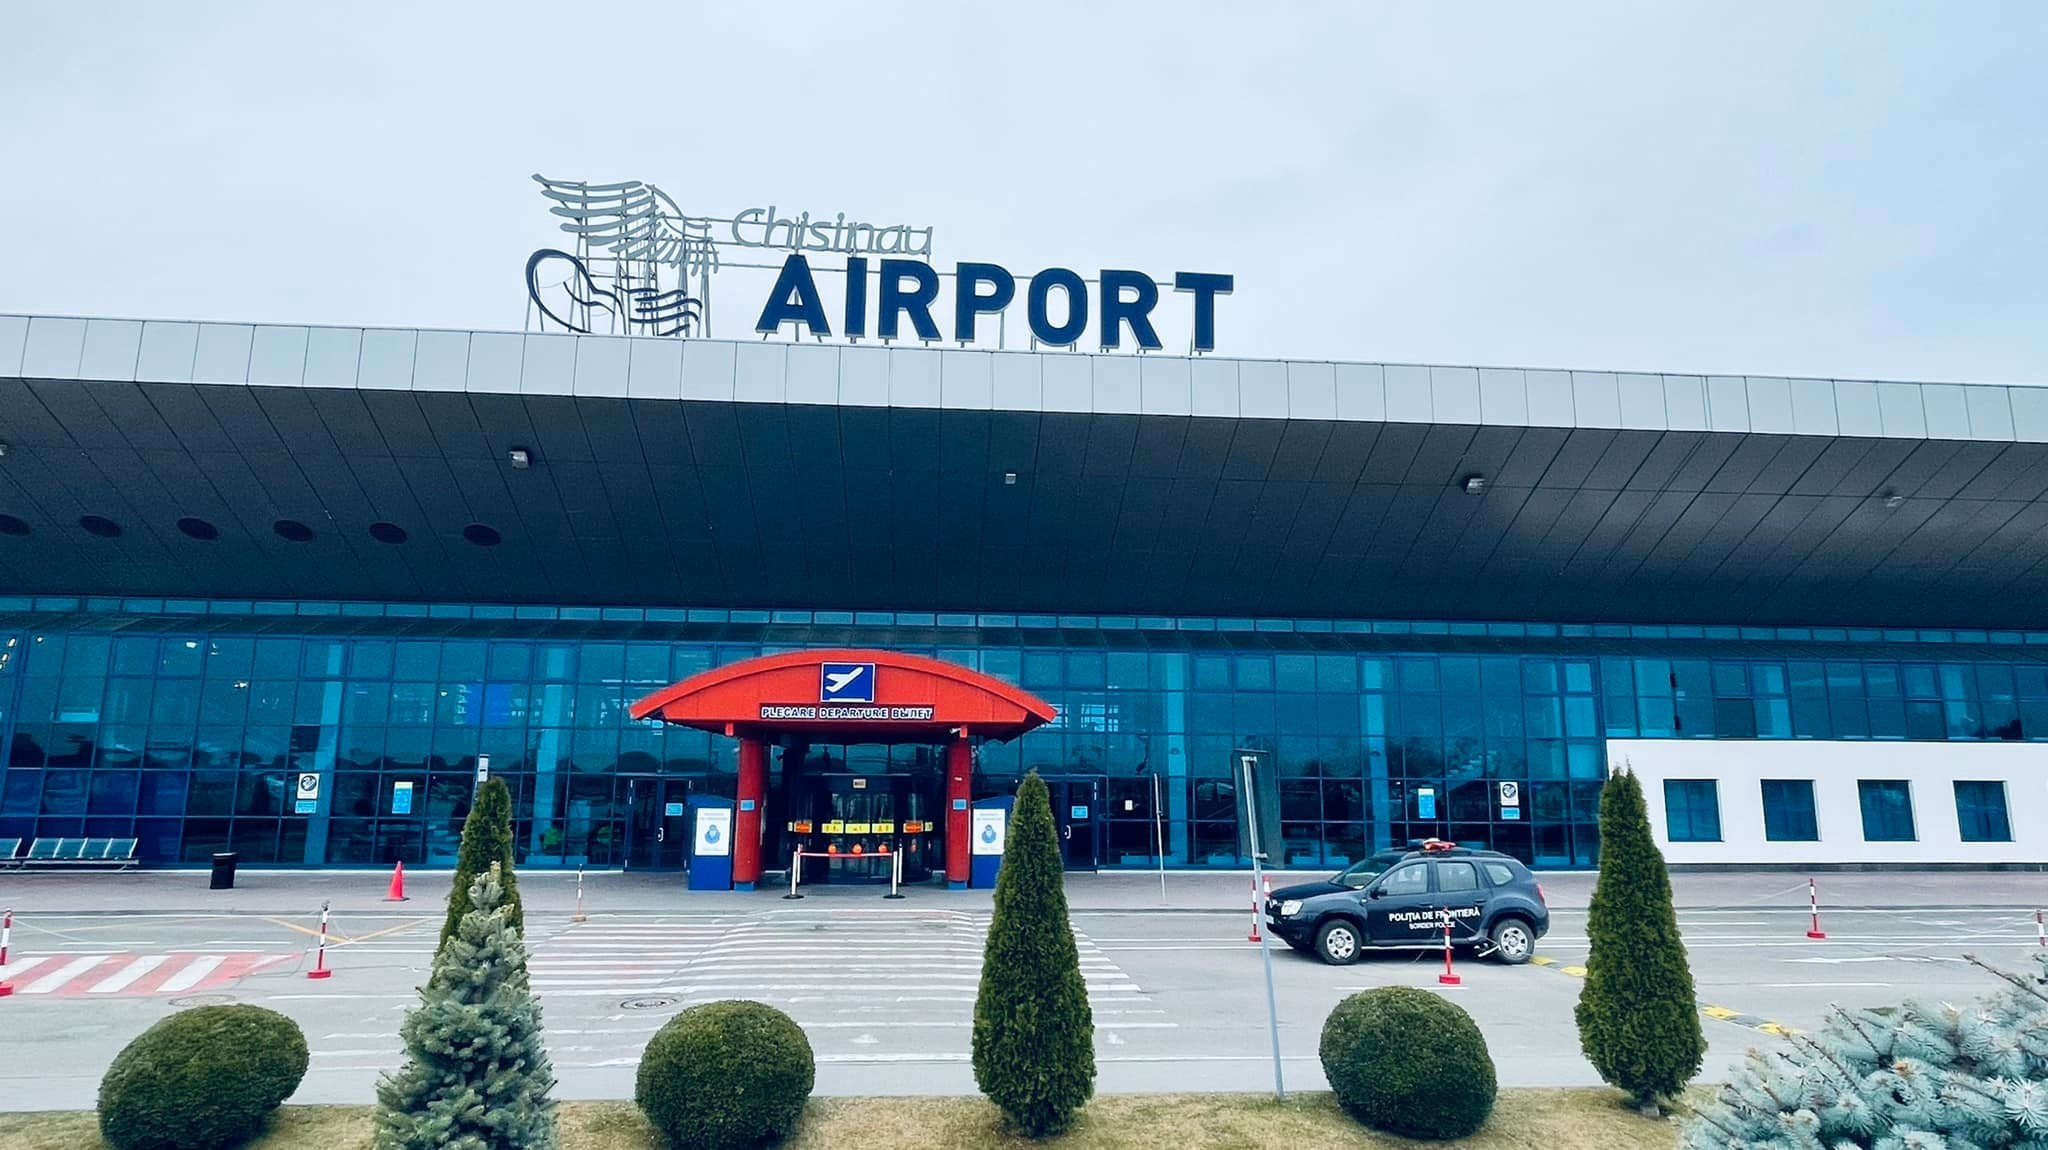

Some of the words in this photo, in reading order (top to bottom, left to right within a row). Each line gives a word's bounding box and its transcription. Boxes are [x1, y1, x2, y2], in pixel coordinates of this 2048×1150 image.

[732, 206, 933, 256] Chisinau
[755, 255, 1234, 352] AIRPORT
[761, 706, 816, 719] PLECARE
[819, 707, 888, 720] DEPARTURE
[891, 707, 933, 720] ВЫЛЕТ
[1422, 911, 1434, 920] DE
